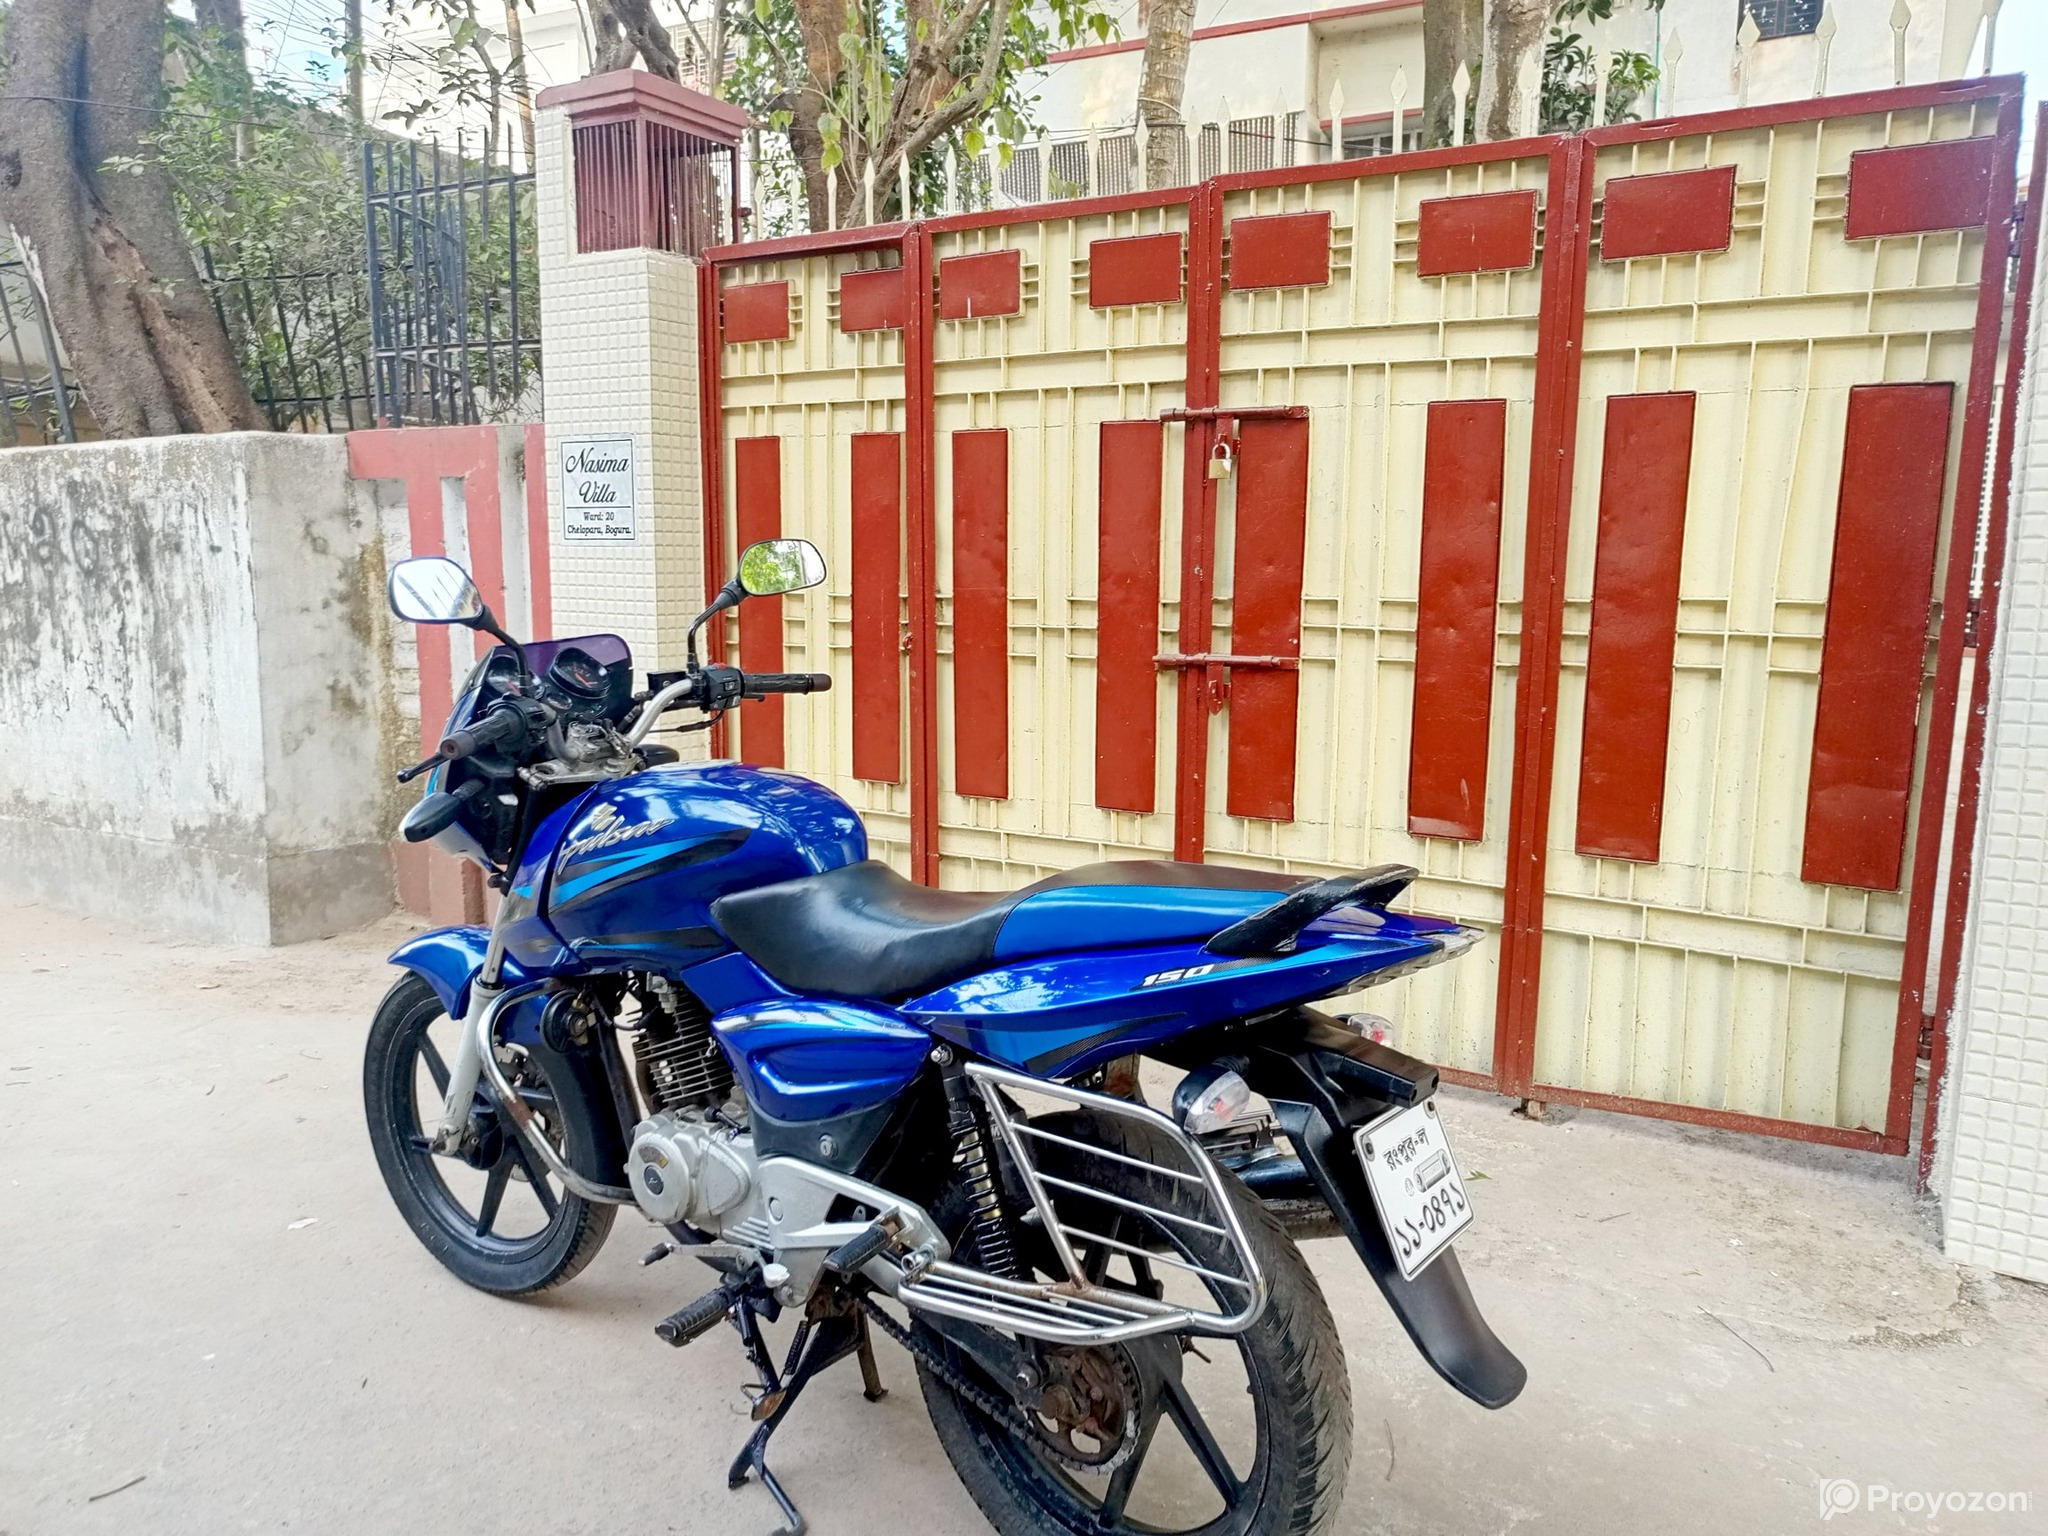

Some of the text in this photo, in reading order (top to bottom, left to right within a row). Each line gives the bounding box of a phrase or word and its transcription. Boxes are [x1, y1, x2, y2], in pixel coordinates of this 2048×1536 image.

[566, 447, 630, 473] Nasima
[579, 481, 617, 503] Villa
[583, 511, 615, 521] Ward: 20
[1143, 964, 1214, 987] 150
